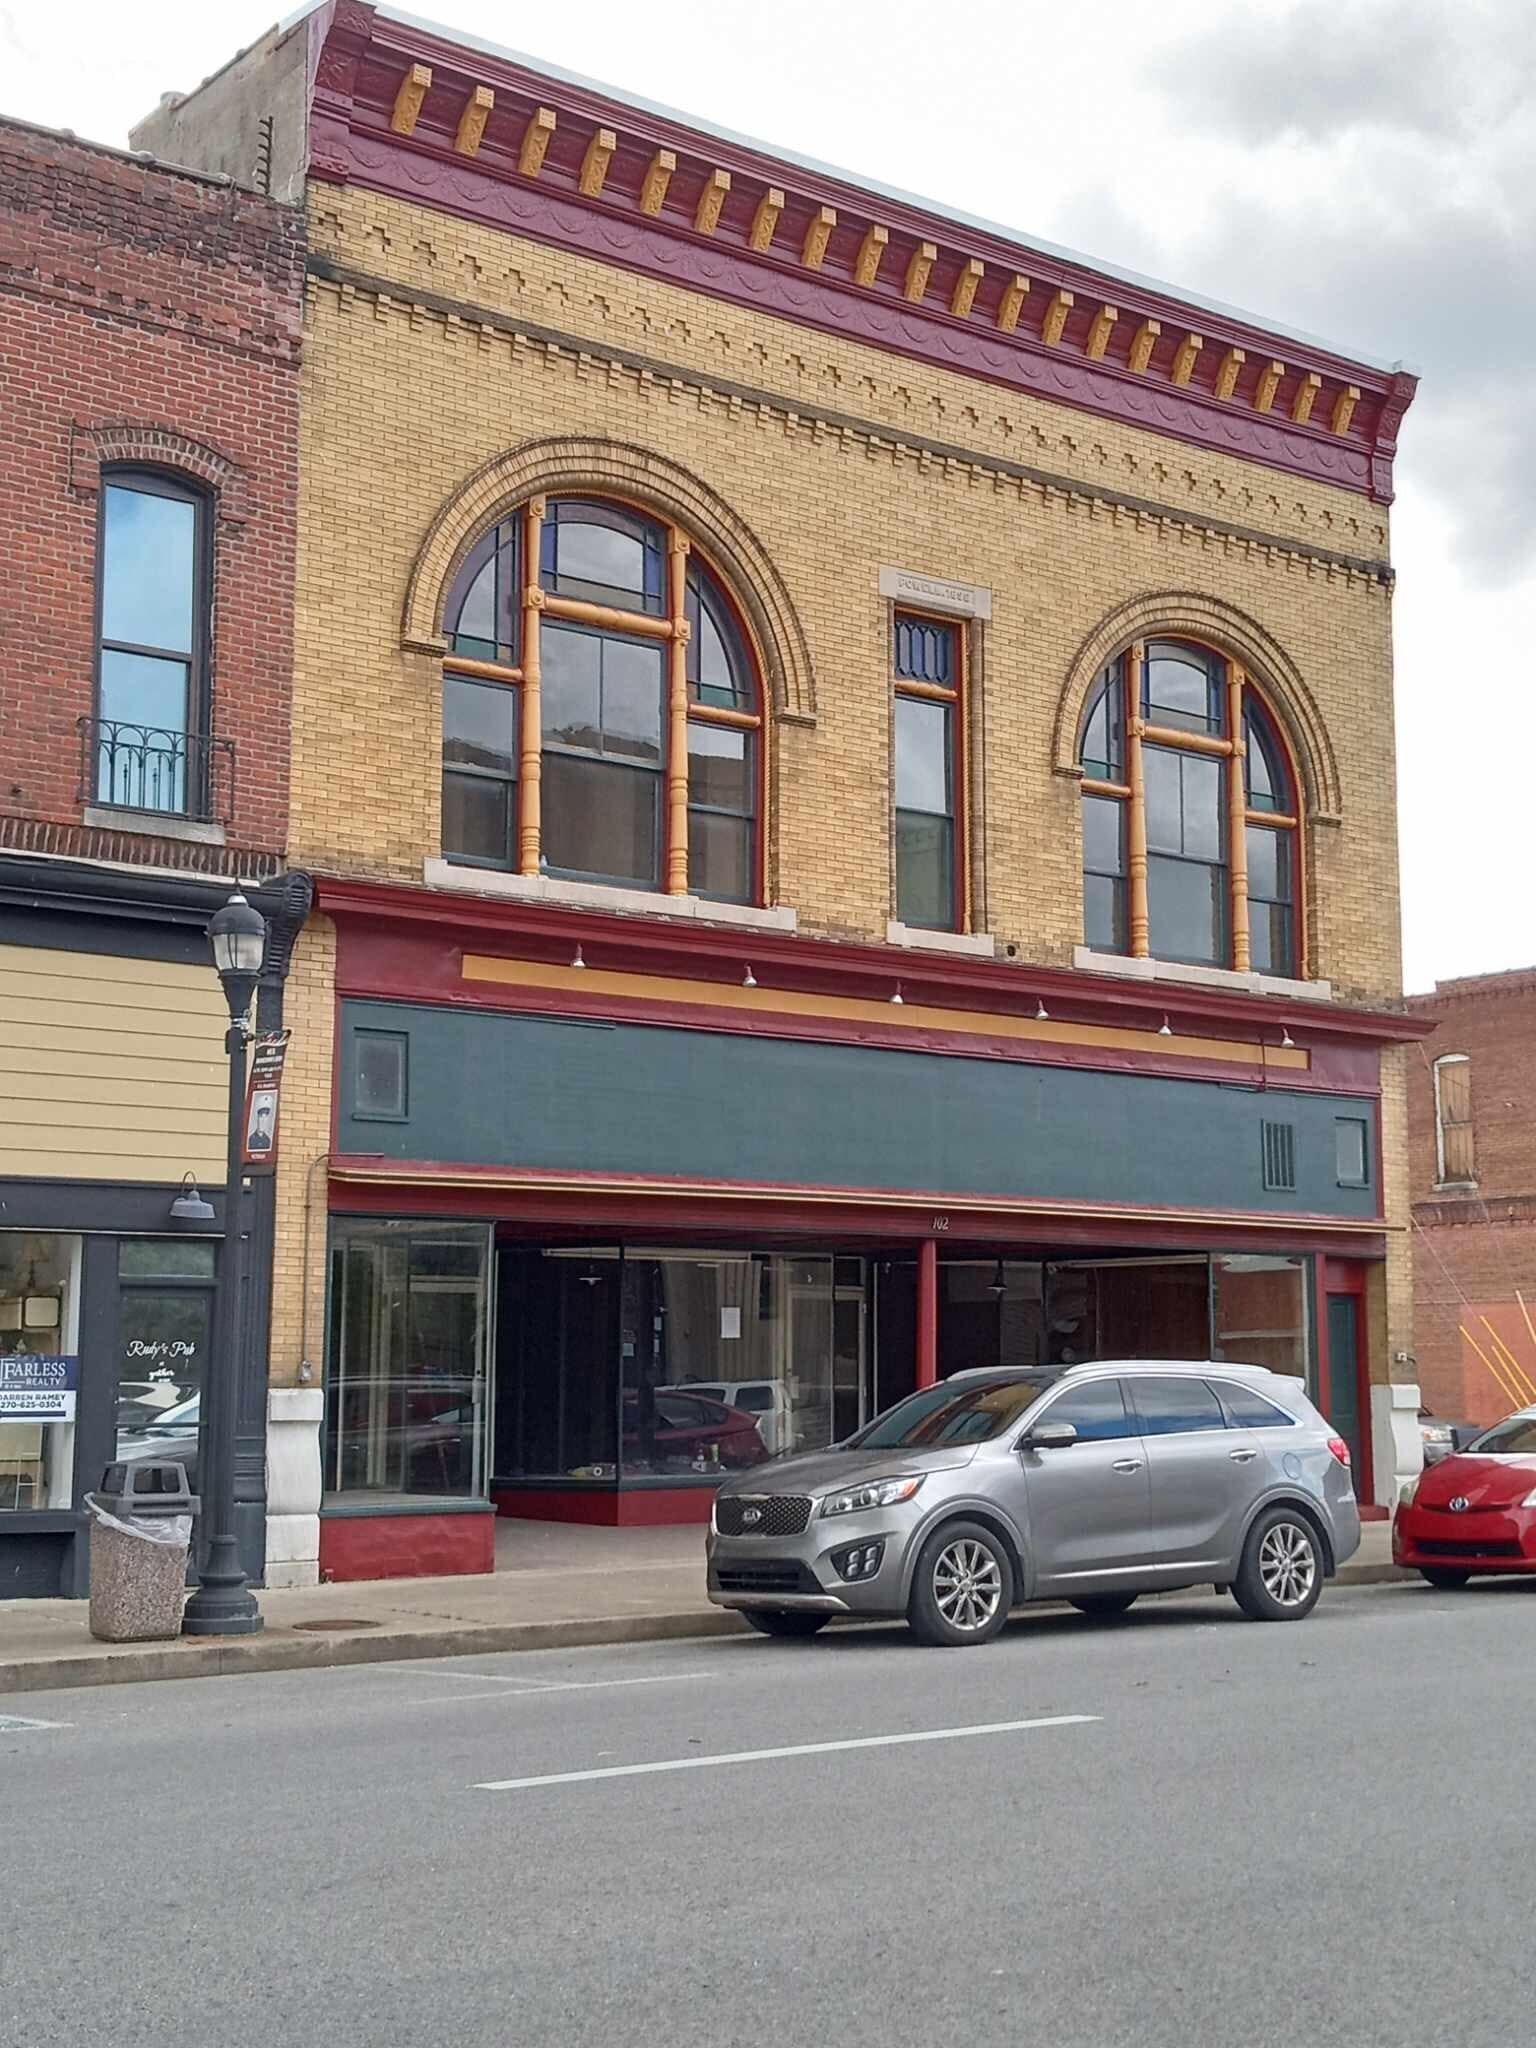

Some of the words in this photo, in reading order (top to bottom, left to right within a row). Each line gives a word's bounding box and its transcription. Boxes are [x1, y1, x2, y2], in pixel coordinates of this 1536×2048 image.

[932, 1216, 949, 1230] 102
[126, 1340, 168, 1360] Rudy's
[169, 1341, 195, 1357] Pub
[4, 1361, 67, 1380] FARLESS
[25, 1377, 61, 1386] REALTY
[0, 1401, 62, 1409] 270-625-0304
